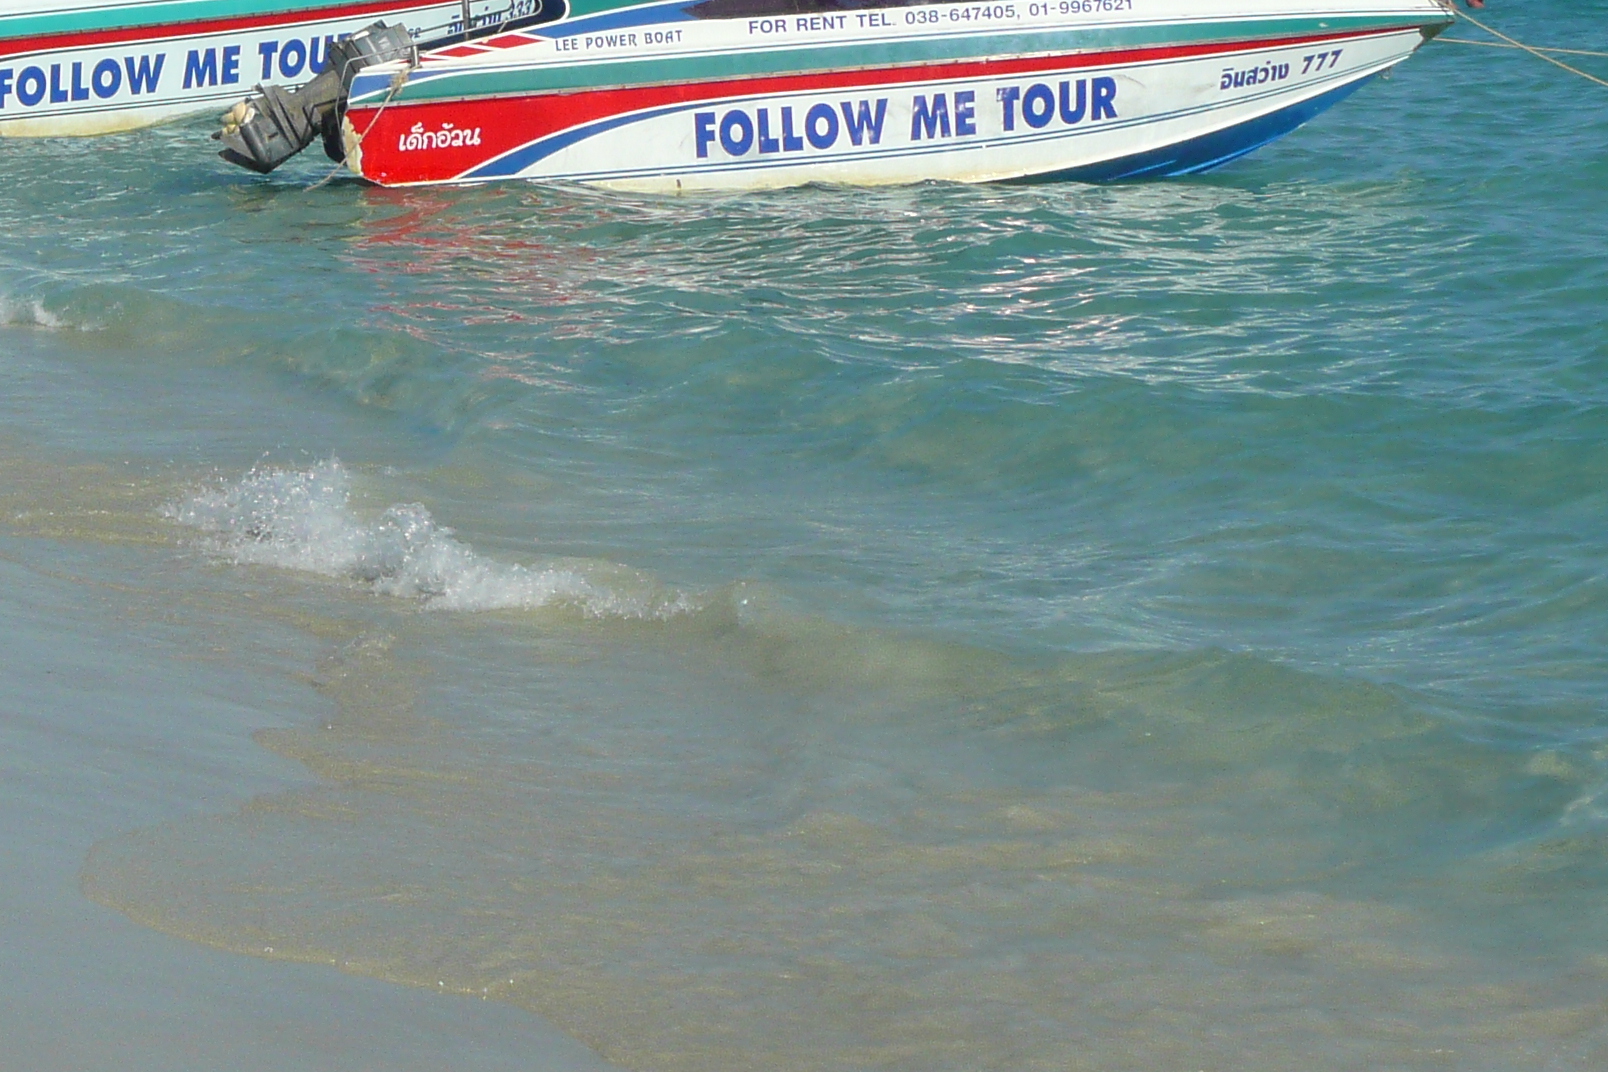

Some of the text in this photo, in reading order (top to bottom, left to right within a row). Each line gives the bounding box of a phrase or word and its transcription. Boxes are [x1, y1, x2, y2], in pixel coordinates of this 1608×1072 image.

[555, 30, 682, 52] LEE POWER BOAT
[748, 19, 787, 34] FOR
[796, 15, 847, 31] RENT
[182, 45, 241, 90] ME
[258, 33, 353, 79] TOU
[1220, 49, 1343, 90] อินสว่าง 777
[694, 77, 1118, 158] FOLLOW ME TOUR
[398, 122, 481, 151] เด็กอ้วน
